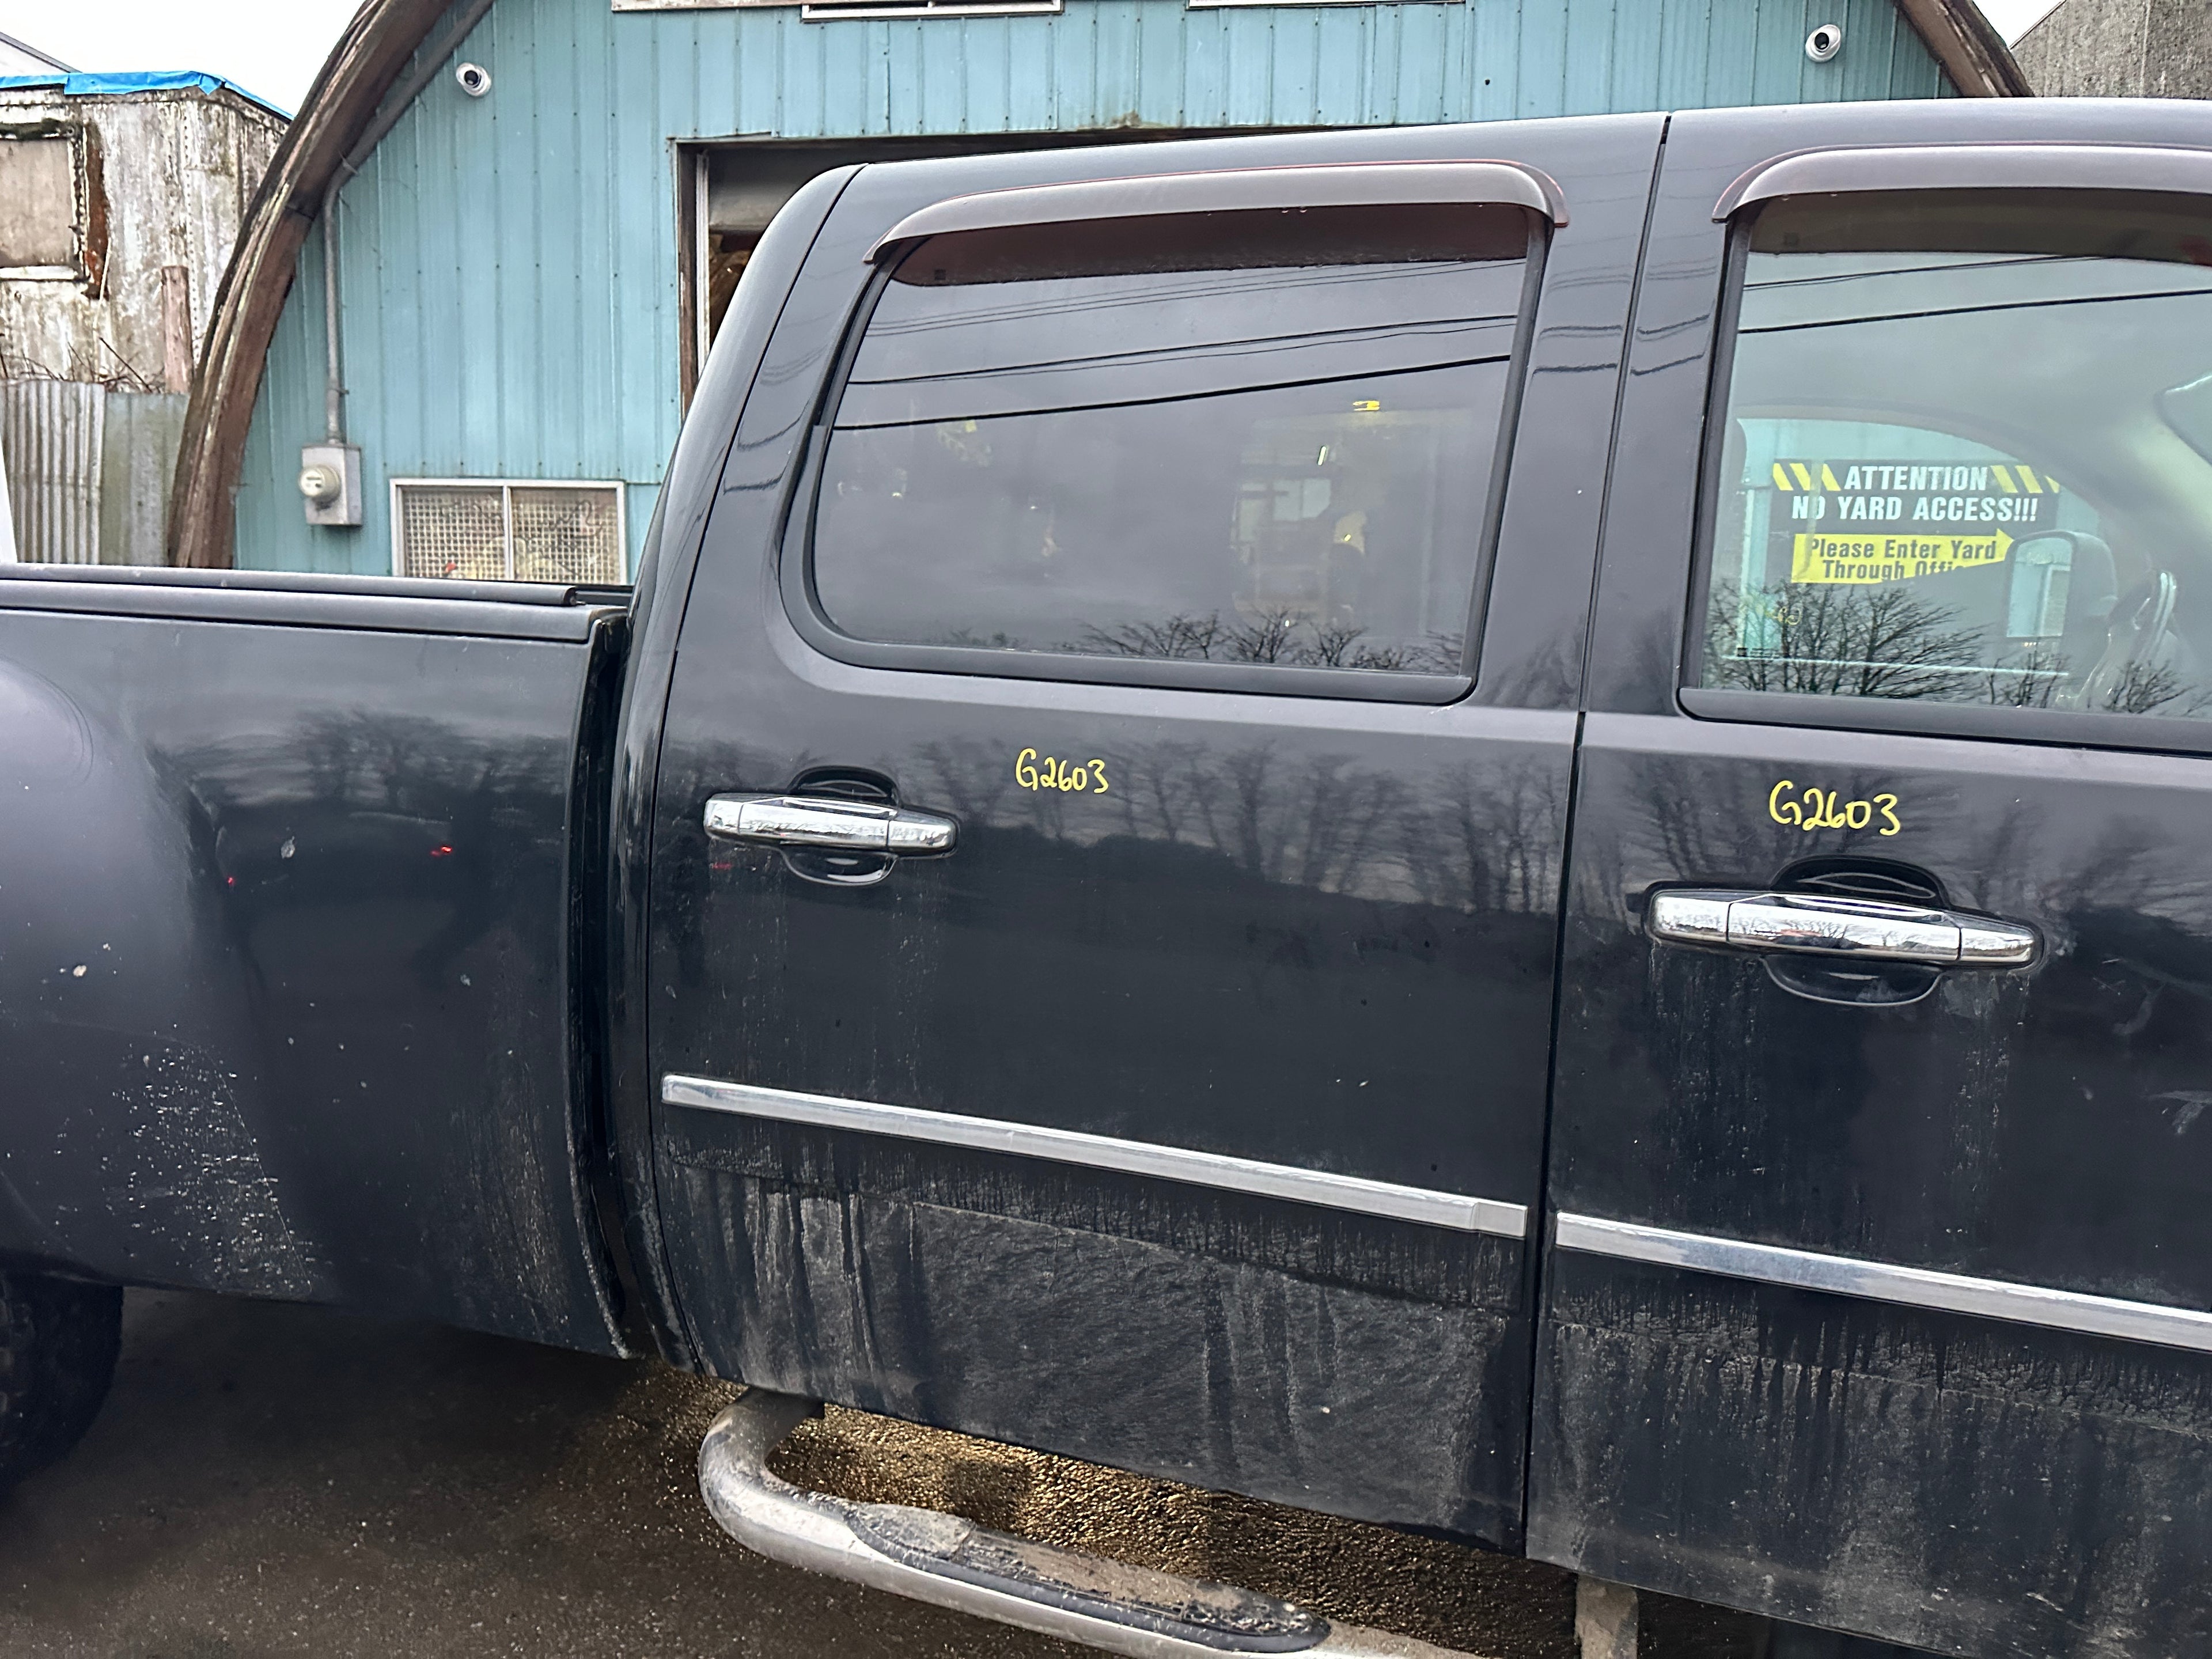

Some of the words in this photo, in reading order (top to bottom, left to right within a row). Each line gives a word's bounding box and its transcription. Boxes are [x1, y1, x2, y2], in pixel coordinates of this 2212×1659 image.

[1844, 465, 1988, 491] ATTENTION
[1792, 495, 1825, 520] NO
[1838, 496, 1902, 520] YARD
[1913, 497, 2039, 521] ACCESS!!!
[1884, 539, 1941, 559] Enter
[1951, 540, 1997, 559] Yard
[1822, 559, 1906, 580] Through
[1915, 560, 1964, 577] Offi
[1016, 748, 1109, 793] G2603
[1769, 780, 1900, 836] G2603
